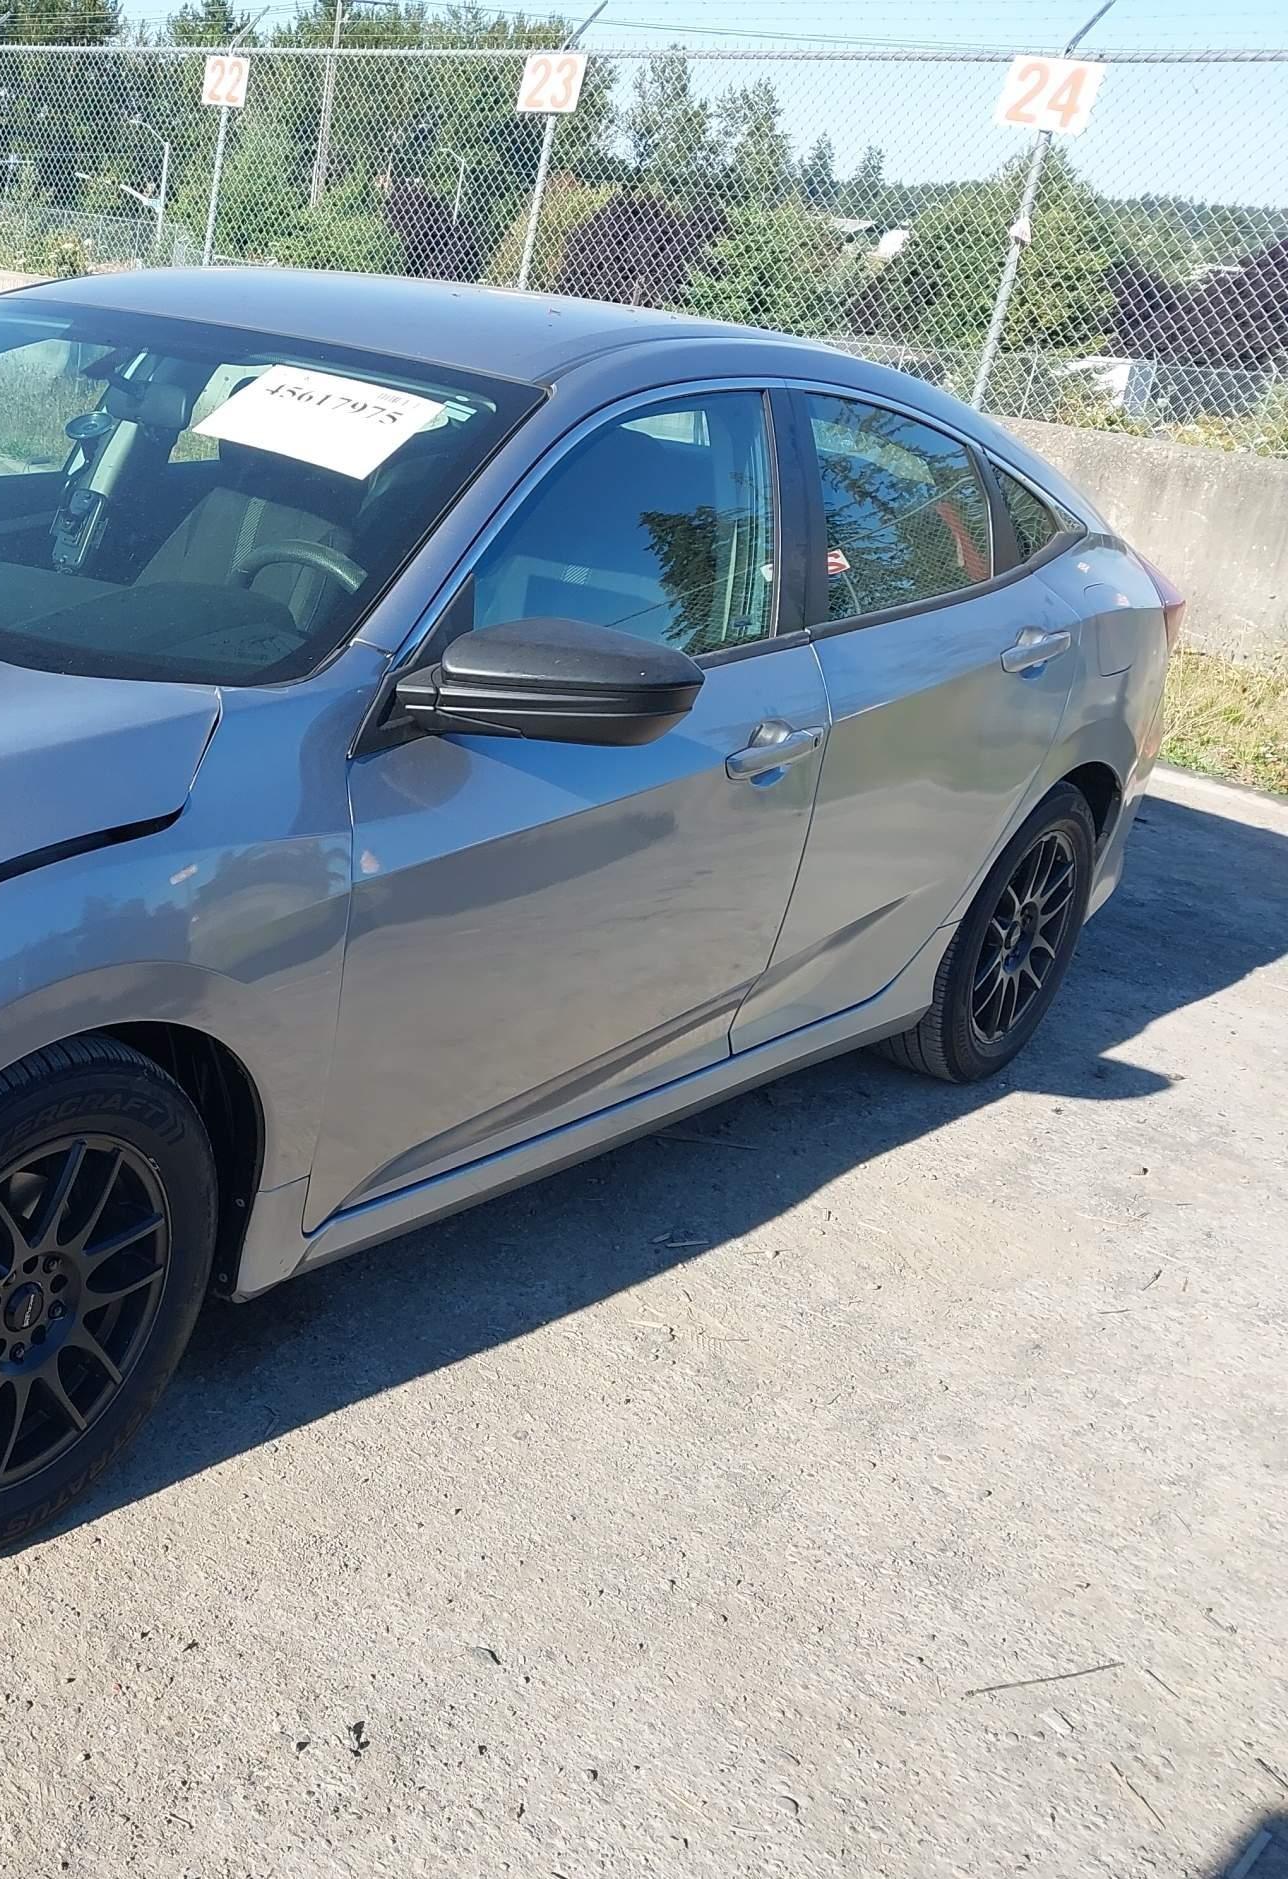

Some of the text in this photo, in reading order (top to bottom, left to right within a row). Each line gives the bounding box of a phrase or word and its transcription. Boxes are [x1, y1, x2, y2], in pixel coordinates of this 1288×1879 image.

[208, 59, 243, 102] 22
[525, 58, 578, 108] 23
[1005, 62, 1088, 128] 24
[266, 383, 404, 424] 45617975
